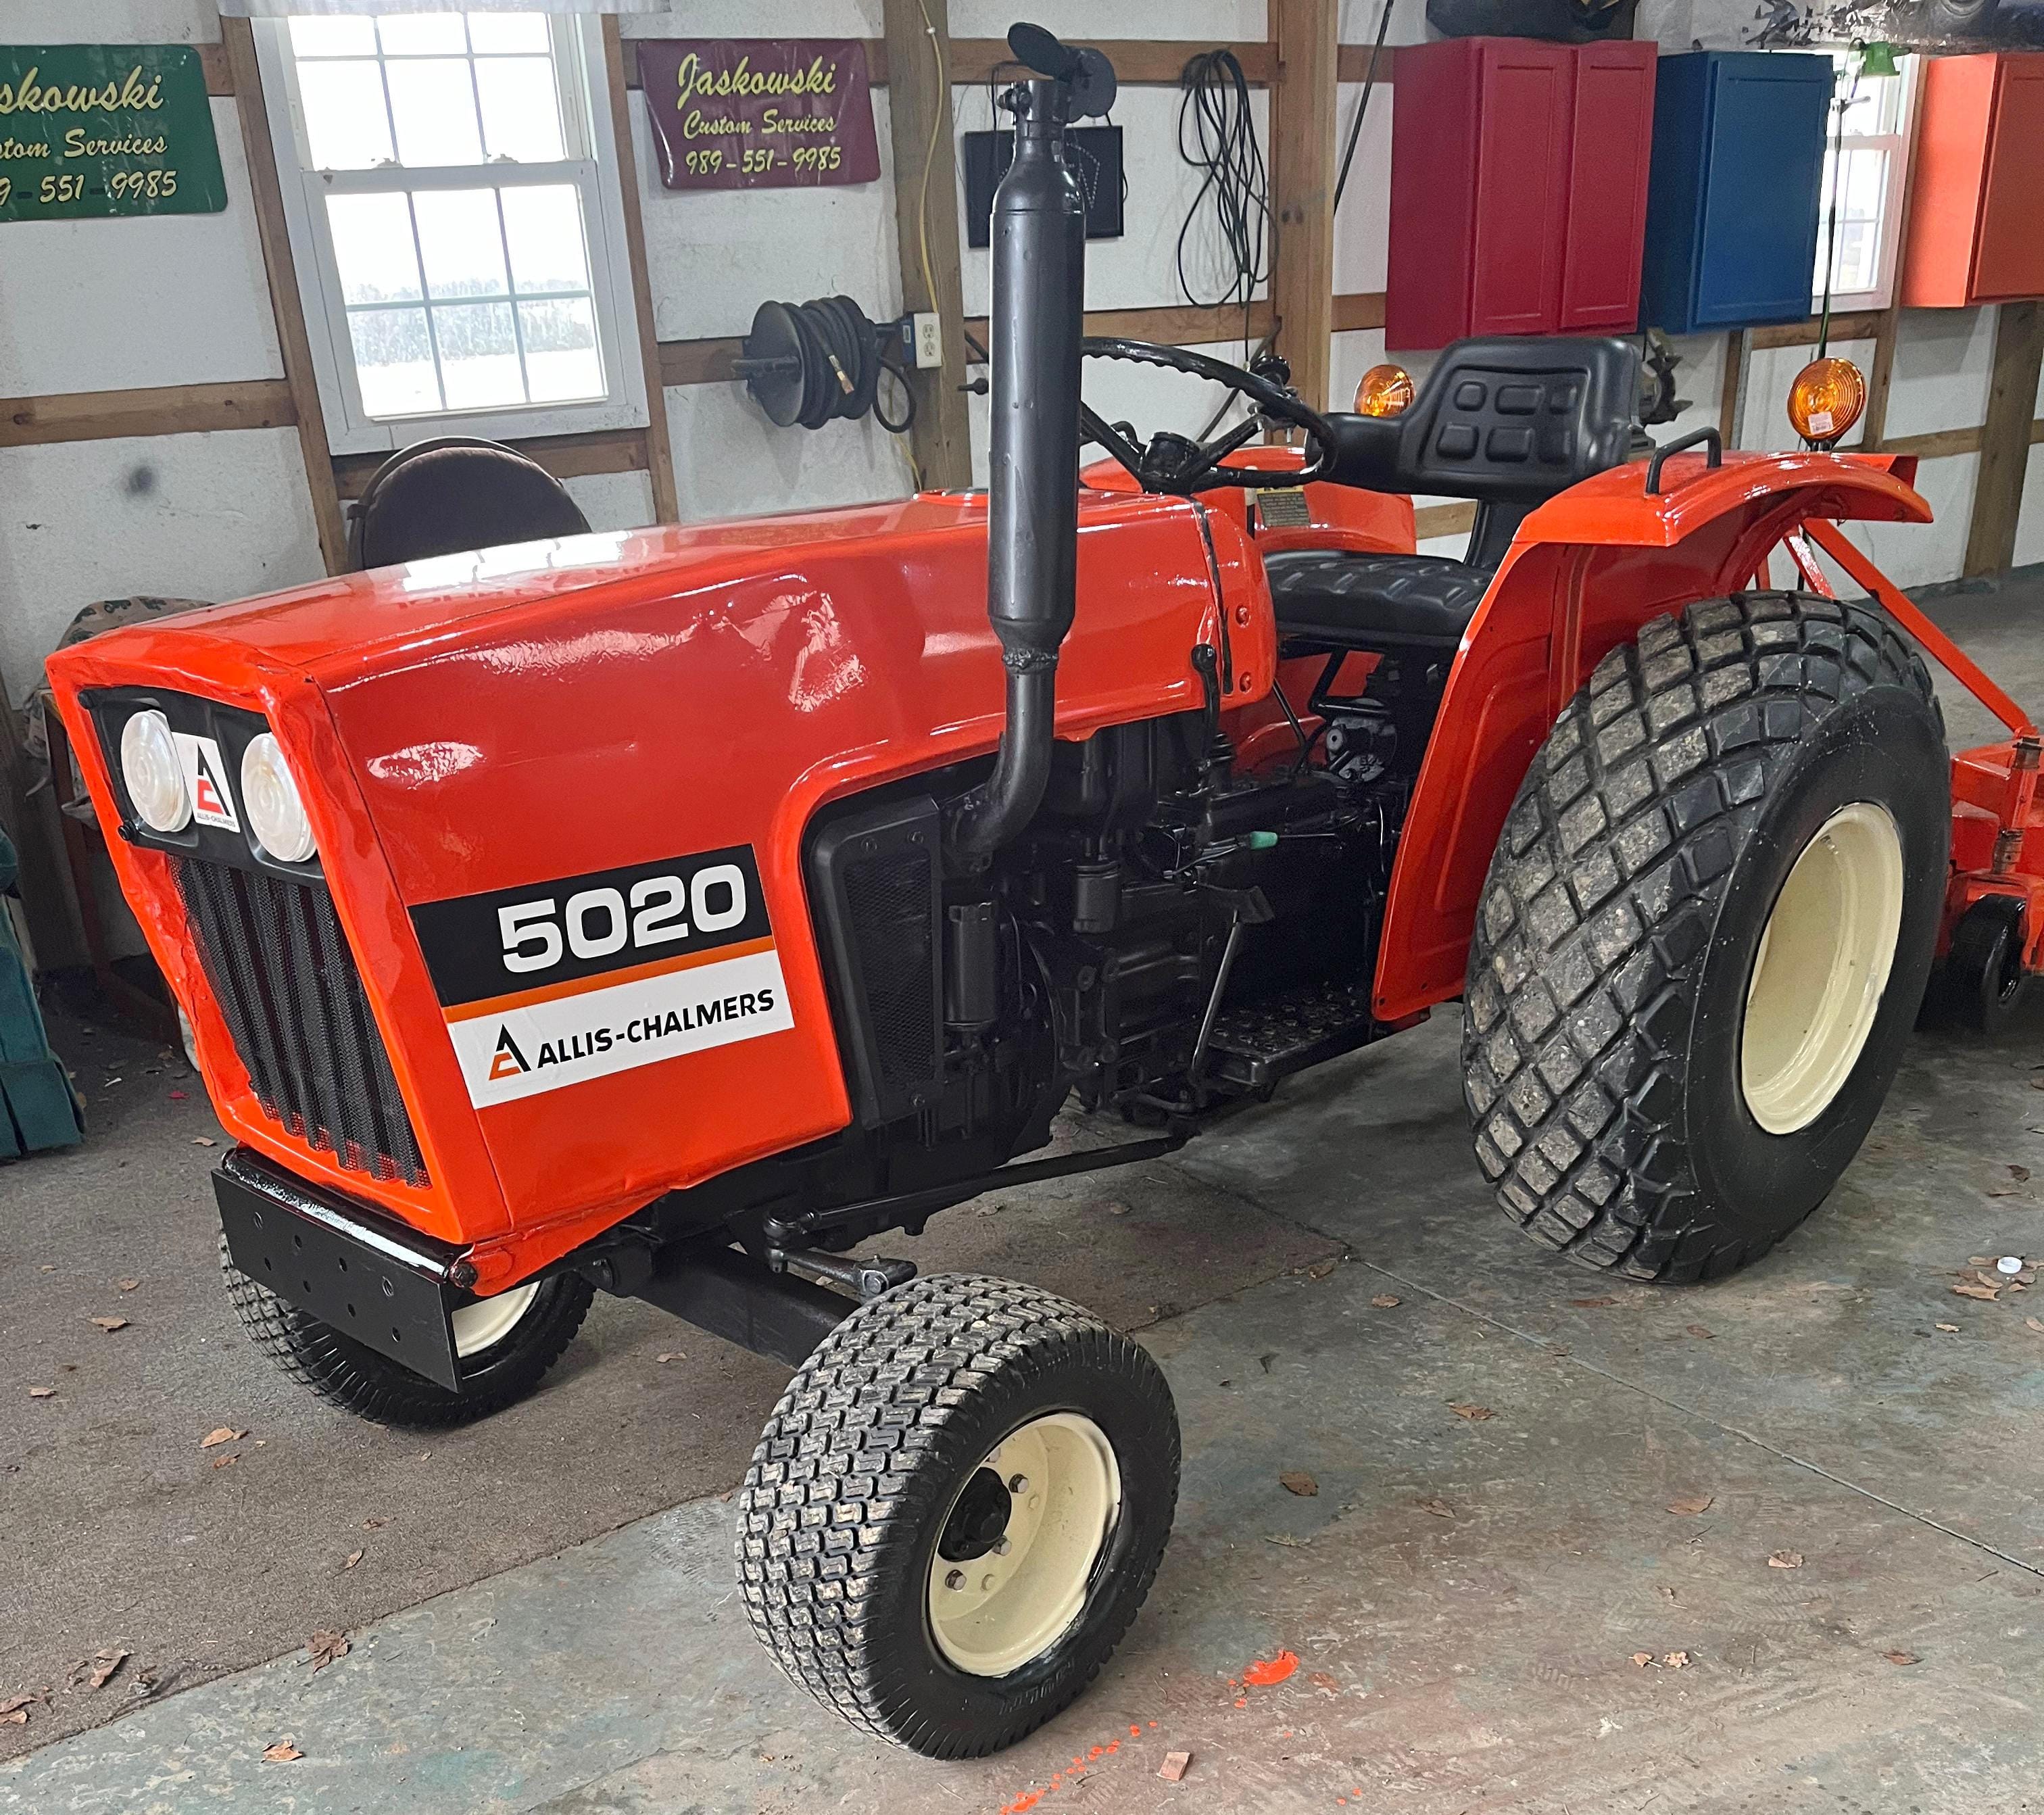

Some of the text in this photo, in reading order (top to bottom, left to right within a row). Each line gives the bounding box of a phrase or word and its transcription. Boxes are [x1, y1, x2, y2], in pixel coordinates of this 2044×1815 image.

[678, 53, 836, 110] Jaskowski
[0, 128, 168, 160] tom Services
[684, 108, 837, 139] Custom Services
[497, 863, 746, 973] 5020
[537, 989, 775, 1069] ALLIS-CHALMERS
